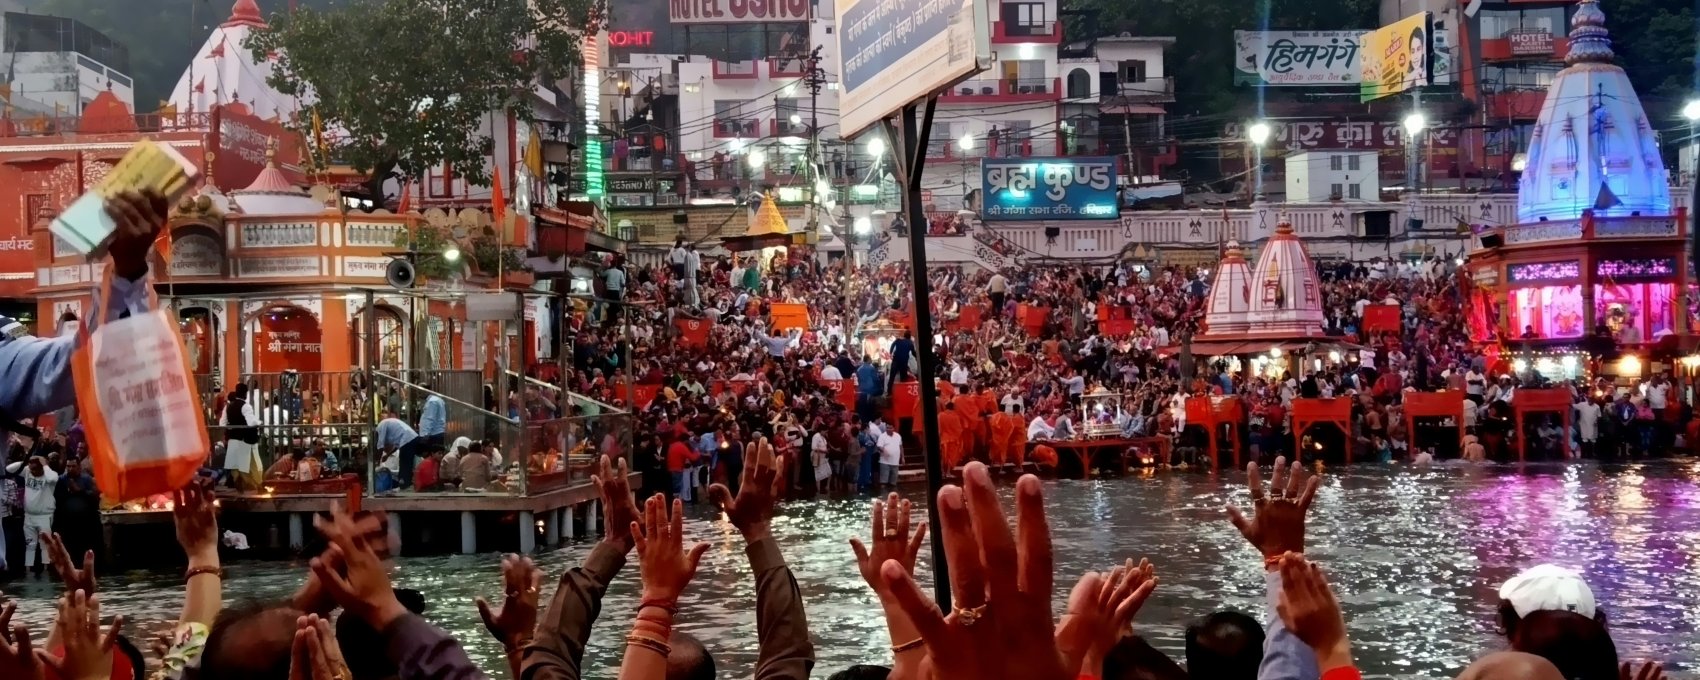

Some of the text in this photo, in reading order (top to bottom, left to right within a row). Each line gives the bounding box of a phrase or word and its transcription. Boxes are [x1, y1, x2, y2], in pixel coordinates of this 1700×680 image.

[1511, 34, 1553, 43] HOTEL
[1264, 38, 1361, 74] हिमगंगे
[985, 162, 1113, 202] ब्रह्म कुण्ड
[987, 203, 1001, 215] श्री
[1002, 203, 1026, 215] गंगा
[1028, 205, 1050, 215] सभा
[267, 339, 282, 352] श्री
[283, 340, 303, 353] गंगा
